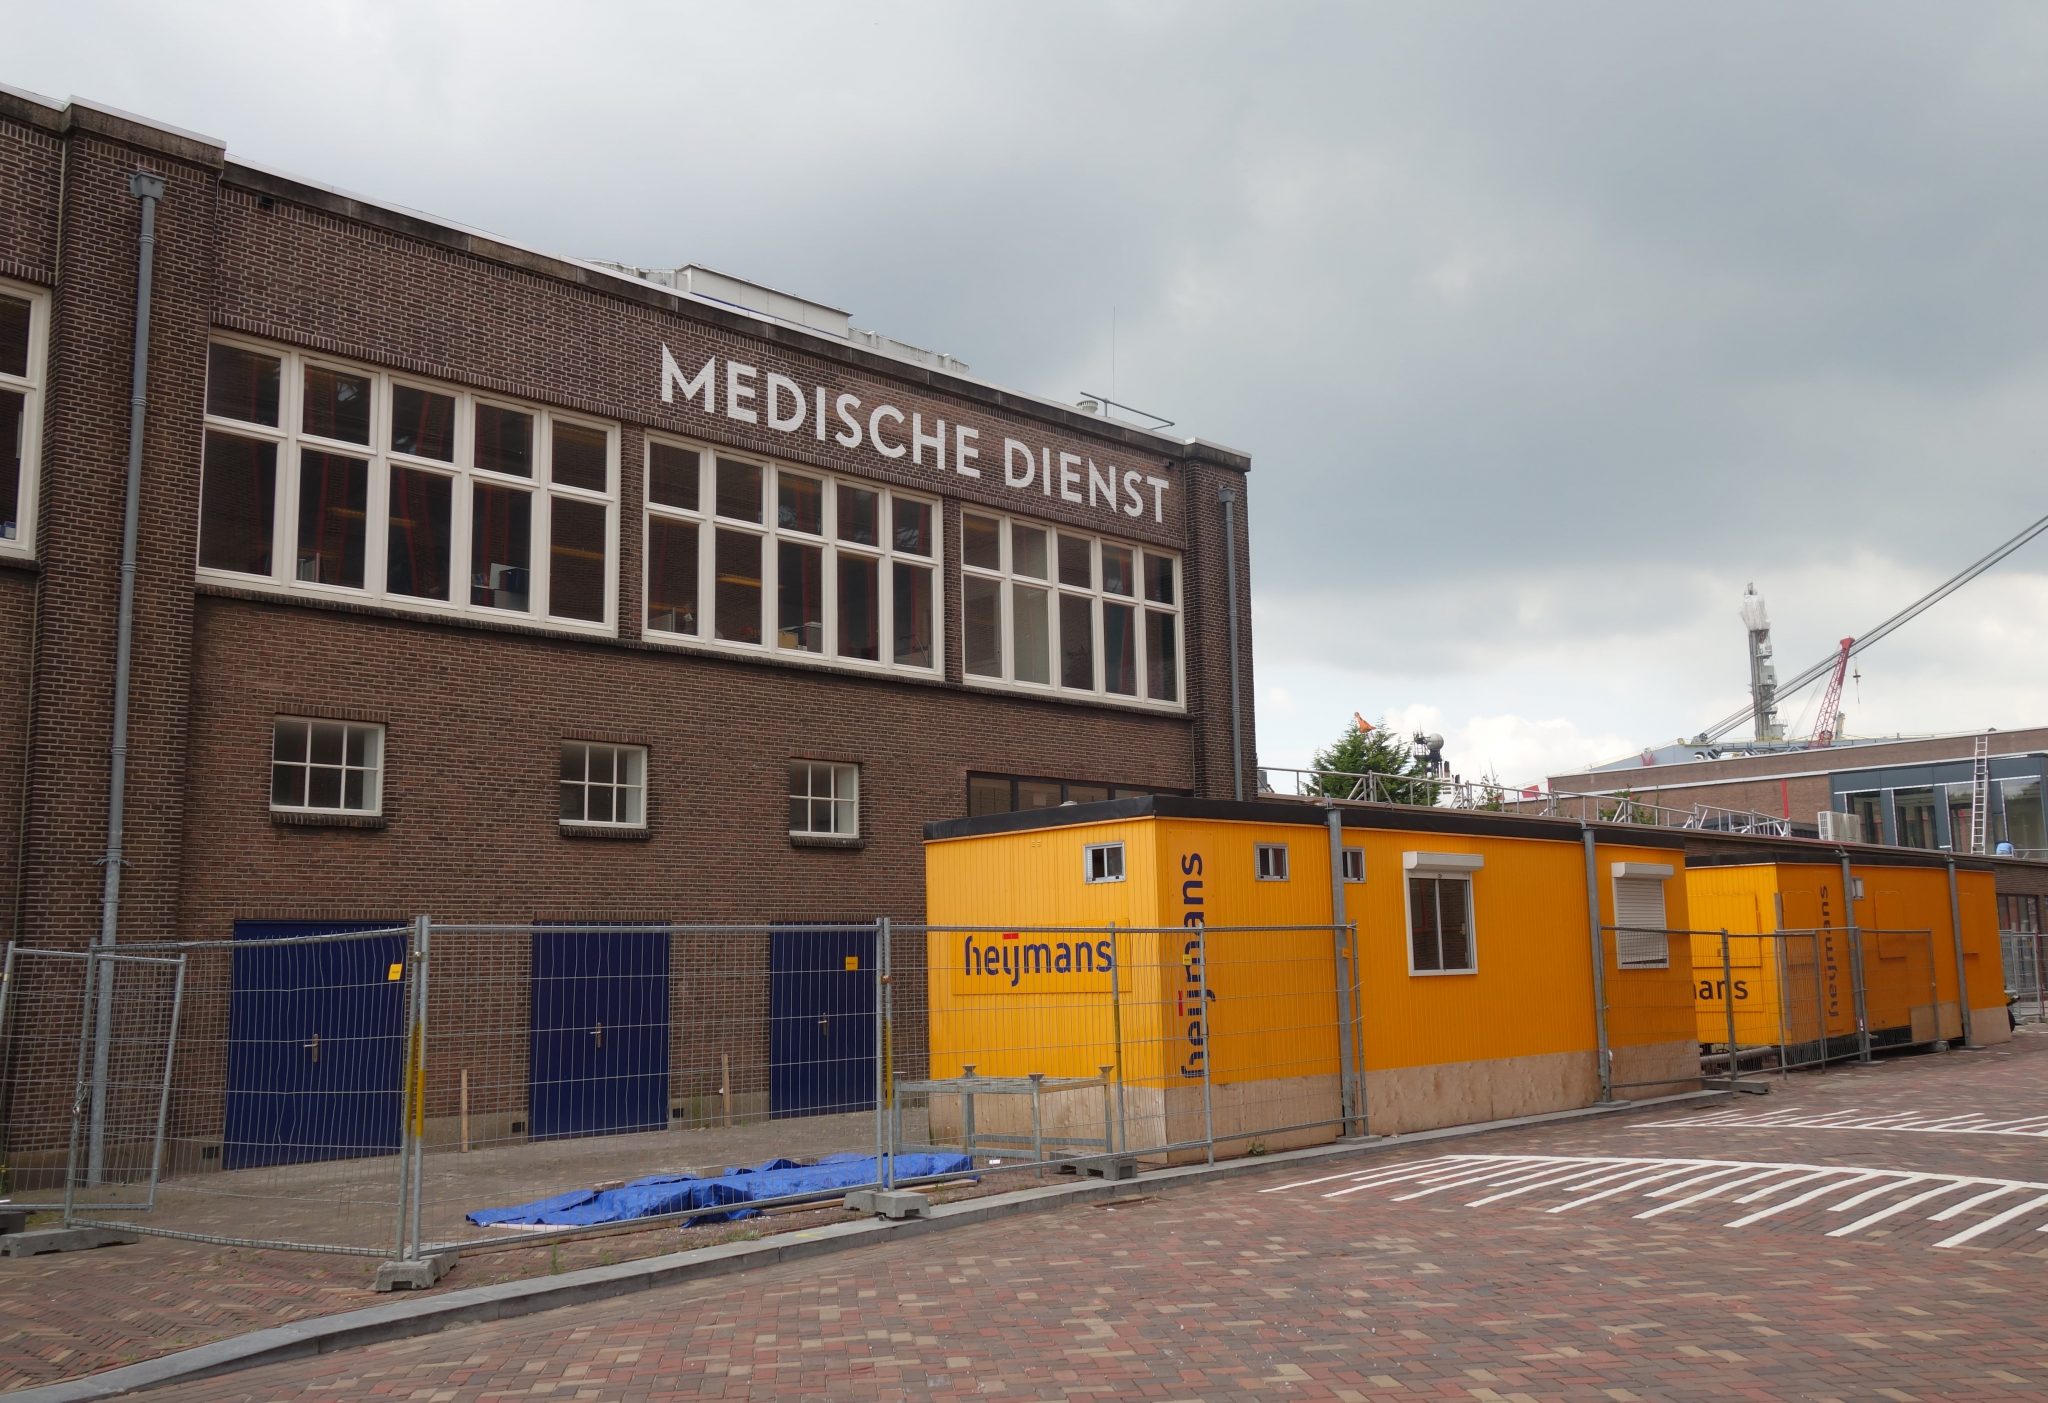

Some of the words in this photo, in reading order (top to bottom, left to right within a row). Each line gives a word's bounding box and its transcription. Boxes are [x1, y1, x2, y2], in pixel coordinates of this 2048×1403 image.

[661, 343, 981, 479] MEDISCHE
[1004, 437, 1169, 523] DIENST
[965, 933, 1113, 987] heijmans
[1178, 852, 1216, 1078] heijmans
[1693, 980, 1749, 1000] ans
